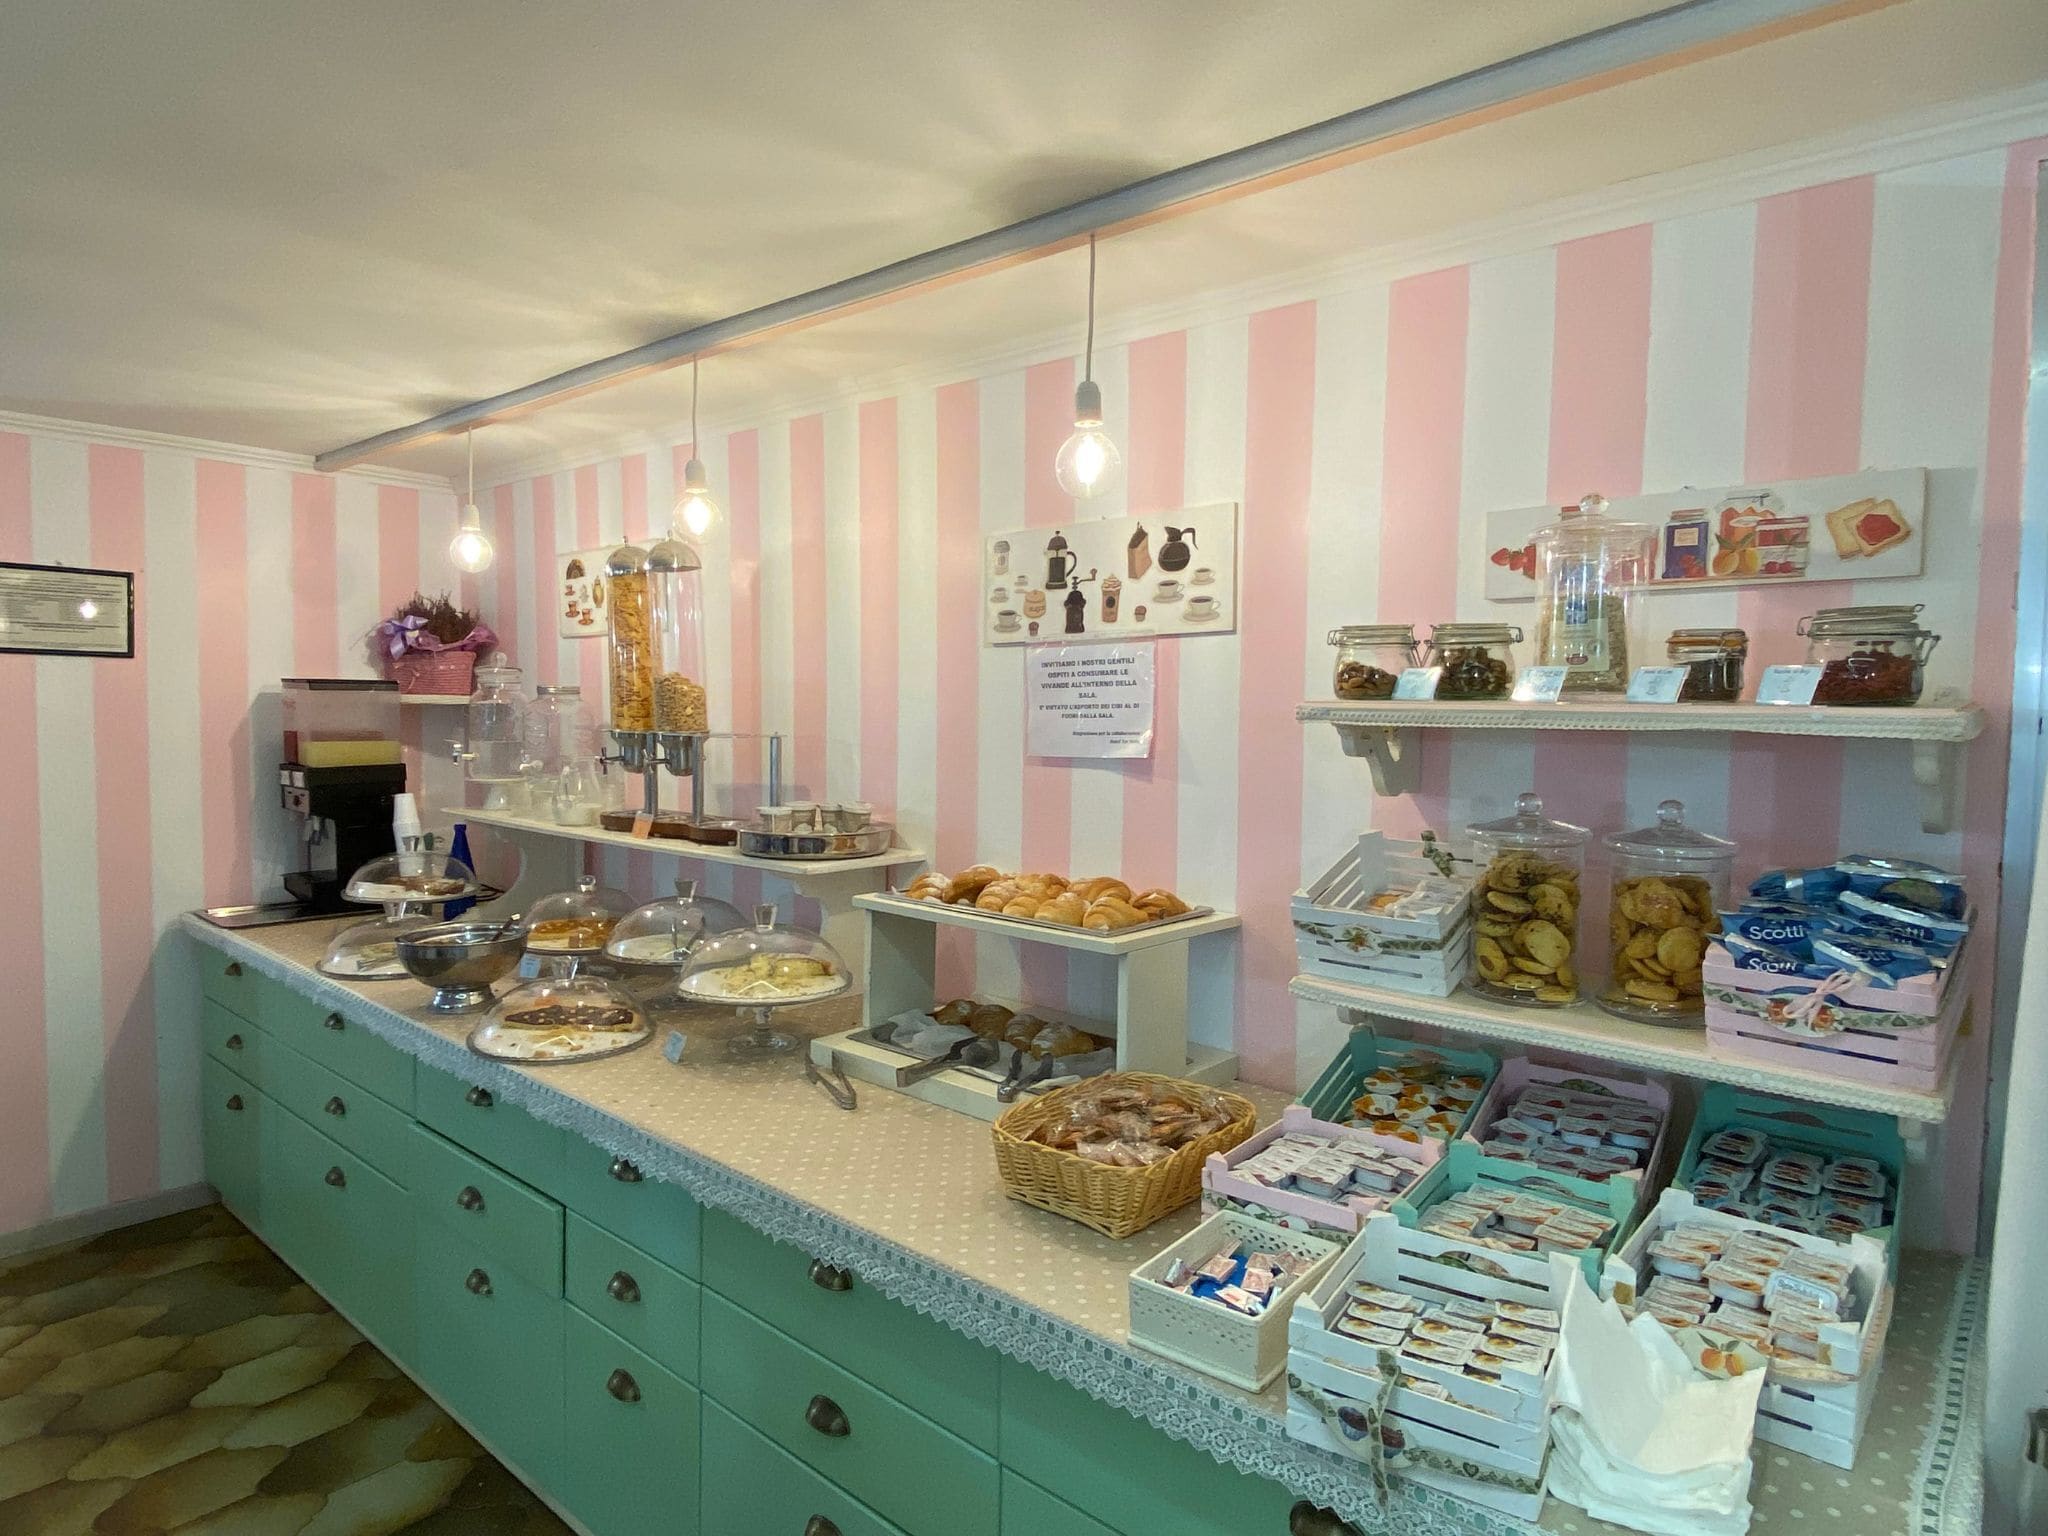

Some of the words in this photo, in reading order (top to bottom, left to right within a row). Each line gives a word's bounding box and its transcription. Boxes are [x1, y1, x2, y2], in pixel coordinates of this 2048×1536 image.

[1081, 658, 1106, 666] NOSTRI
[1107, 657, 1135, 665] GENTILI
[1047, 671, 1070, 679] OSPITI
[1077, 669, 1118, 677] CONSUMARE
[1115, 679, 1137, 687] DELLA
[1748, 925, 1805, 940] Scotti
